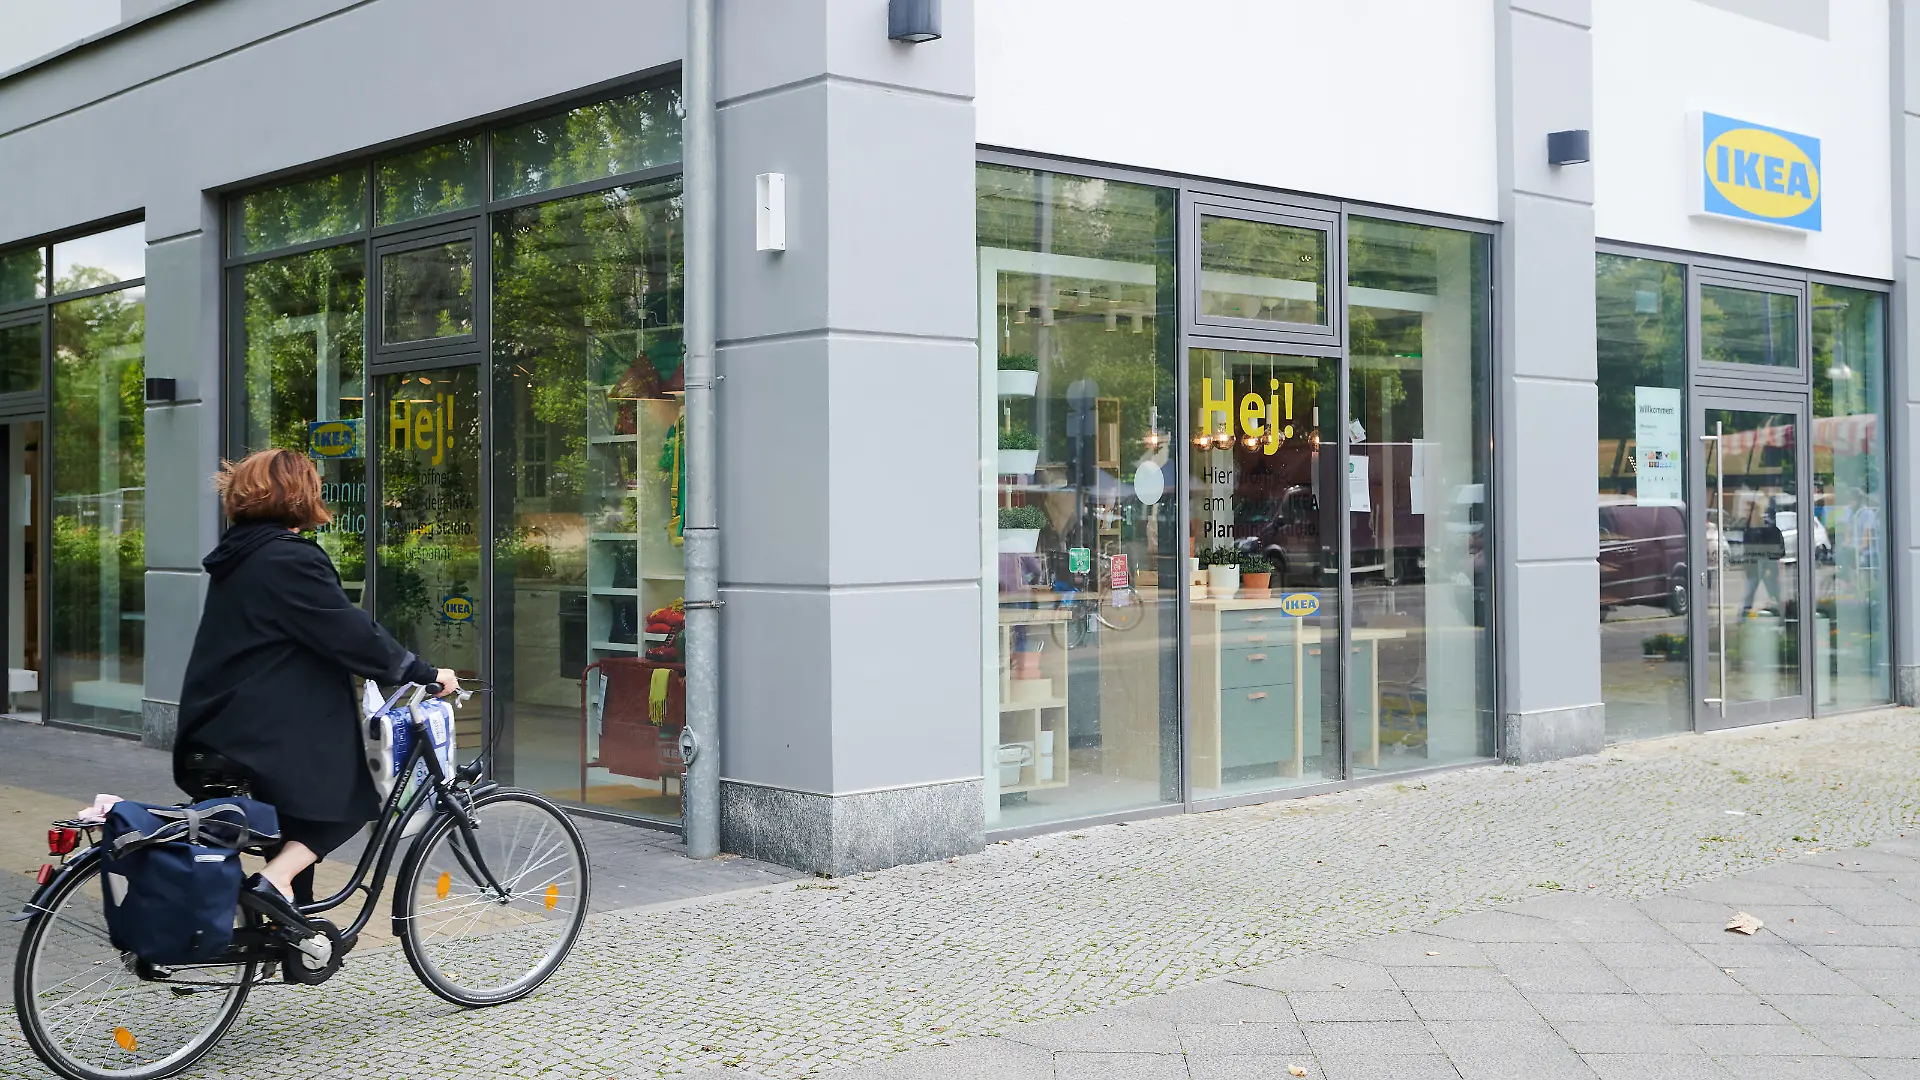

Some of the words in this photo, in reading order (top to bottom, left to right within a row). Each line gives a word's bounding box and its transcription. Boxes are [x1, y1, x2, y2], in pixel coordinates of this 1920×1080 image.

[1716, 144, 1812, 200] IKEA
[1202, 378, 1294, 456] Hej!
[314, 429, 353, 447] IKEA
[389, 392, 455, 467] Hej!
[1203, 466, 1232, 484] Hier
[1203, 497, 1225, 511] am
[1288, 493, 1320, 511] IKEA
[446, 603, 470, 613] IKEA
[1285, 599, 1316, 610] IKEA
